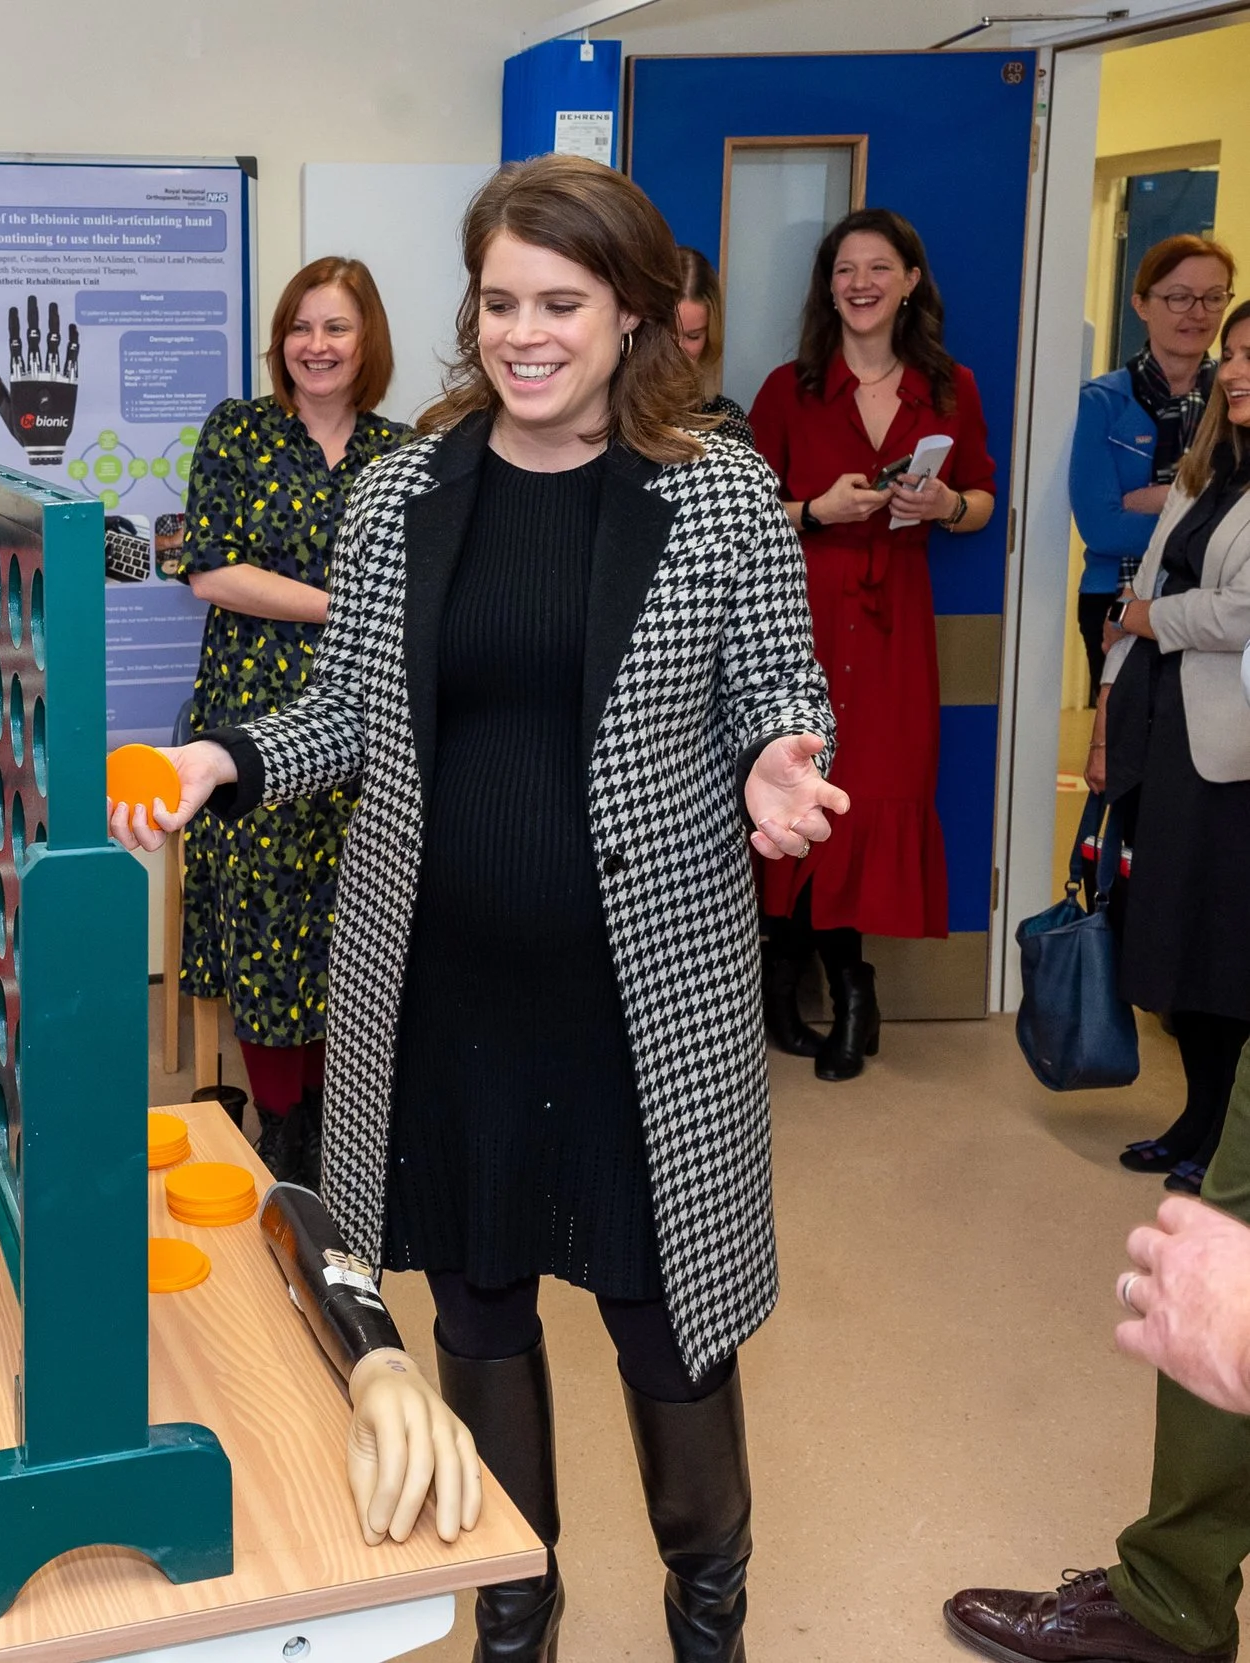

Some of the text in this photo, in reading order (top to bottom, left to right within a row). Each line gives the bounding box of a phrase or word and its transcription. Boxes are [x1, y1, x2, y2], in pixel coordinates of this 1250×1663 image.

[1008, 62, 1023, 73] FD
[559, 113, 611, 121] BEHRENS
[207, 193, 228, 202] NHS
[9, 212, 28, 225] the
[30, 213, 80, 225] Bebionic
[83, 213, 183, 228] multi-articulating
[185, 215, 212, 227] hand
[56, 234, 68, 244] to
[70, 236, 89, 245] use
[92, 233, 120, 245] their
[122, 233, 162, 246] hands?
[20, 255, 61, 263] Co-authors
[137, 256, 166, 264] Clinical
[167, 256, 184, 264] Lead
[52, 267, 100, 276] Occupational
[26, 277, 81, 286] Rehabilitation
[83, 278, 100, 286] Unit
[149, 335, 194, 343] Demographics
